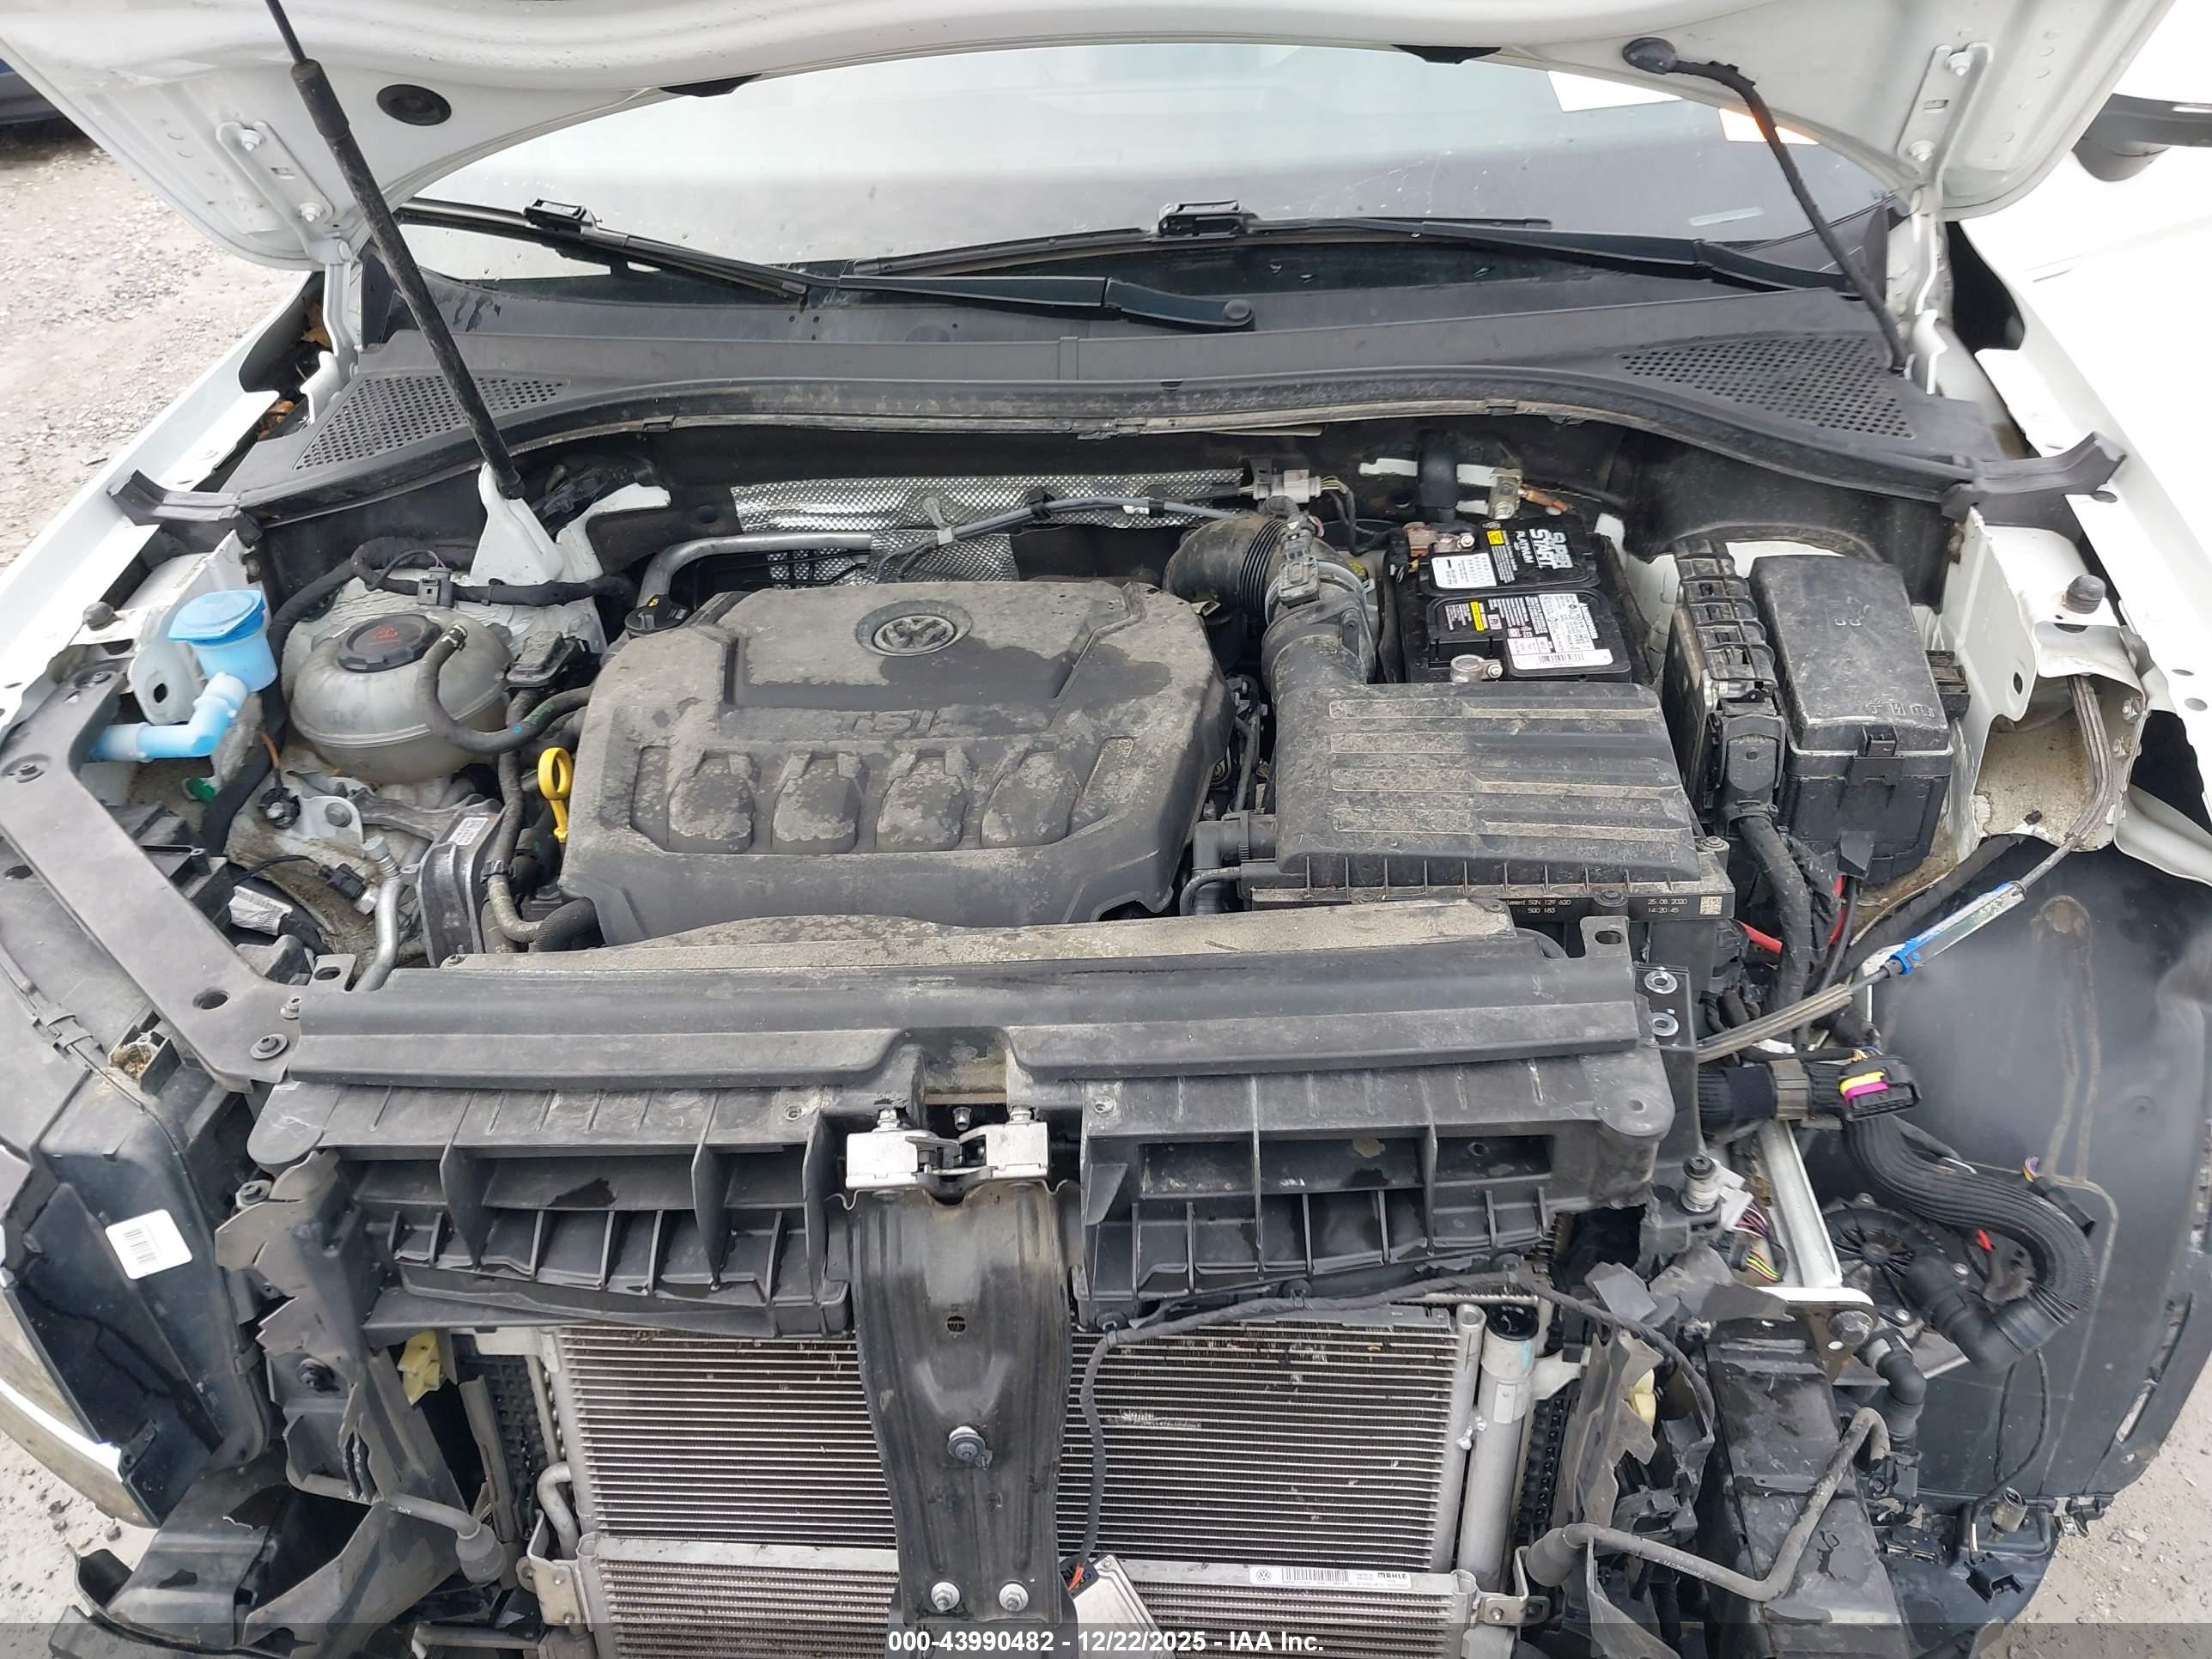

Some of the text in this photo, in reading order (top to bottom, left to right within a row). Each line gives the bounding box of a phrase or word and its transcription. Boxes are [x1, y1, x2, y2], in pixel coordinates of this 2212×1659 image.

[1515, 531, 1534, 563] PLATINUM
[1529, 528, 1557, 569] START
[1545, 532, 1573, 568] SUPER
